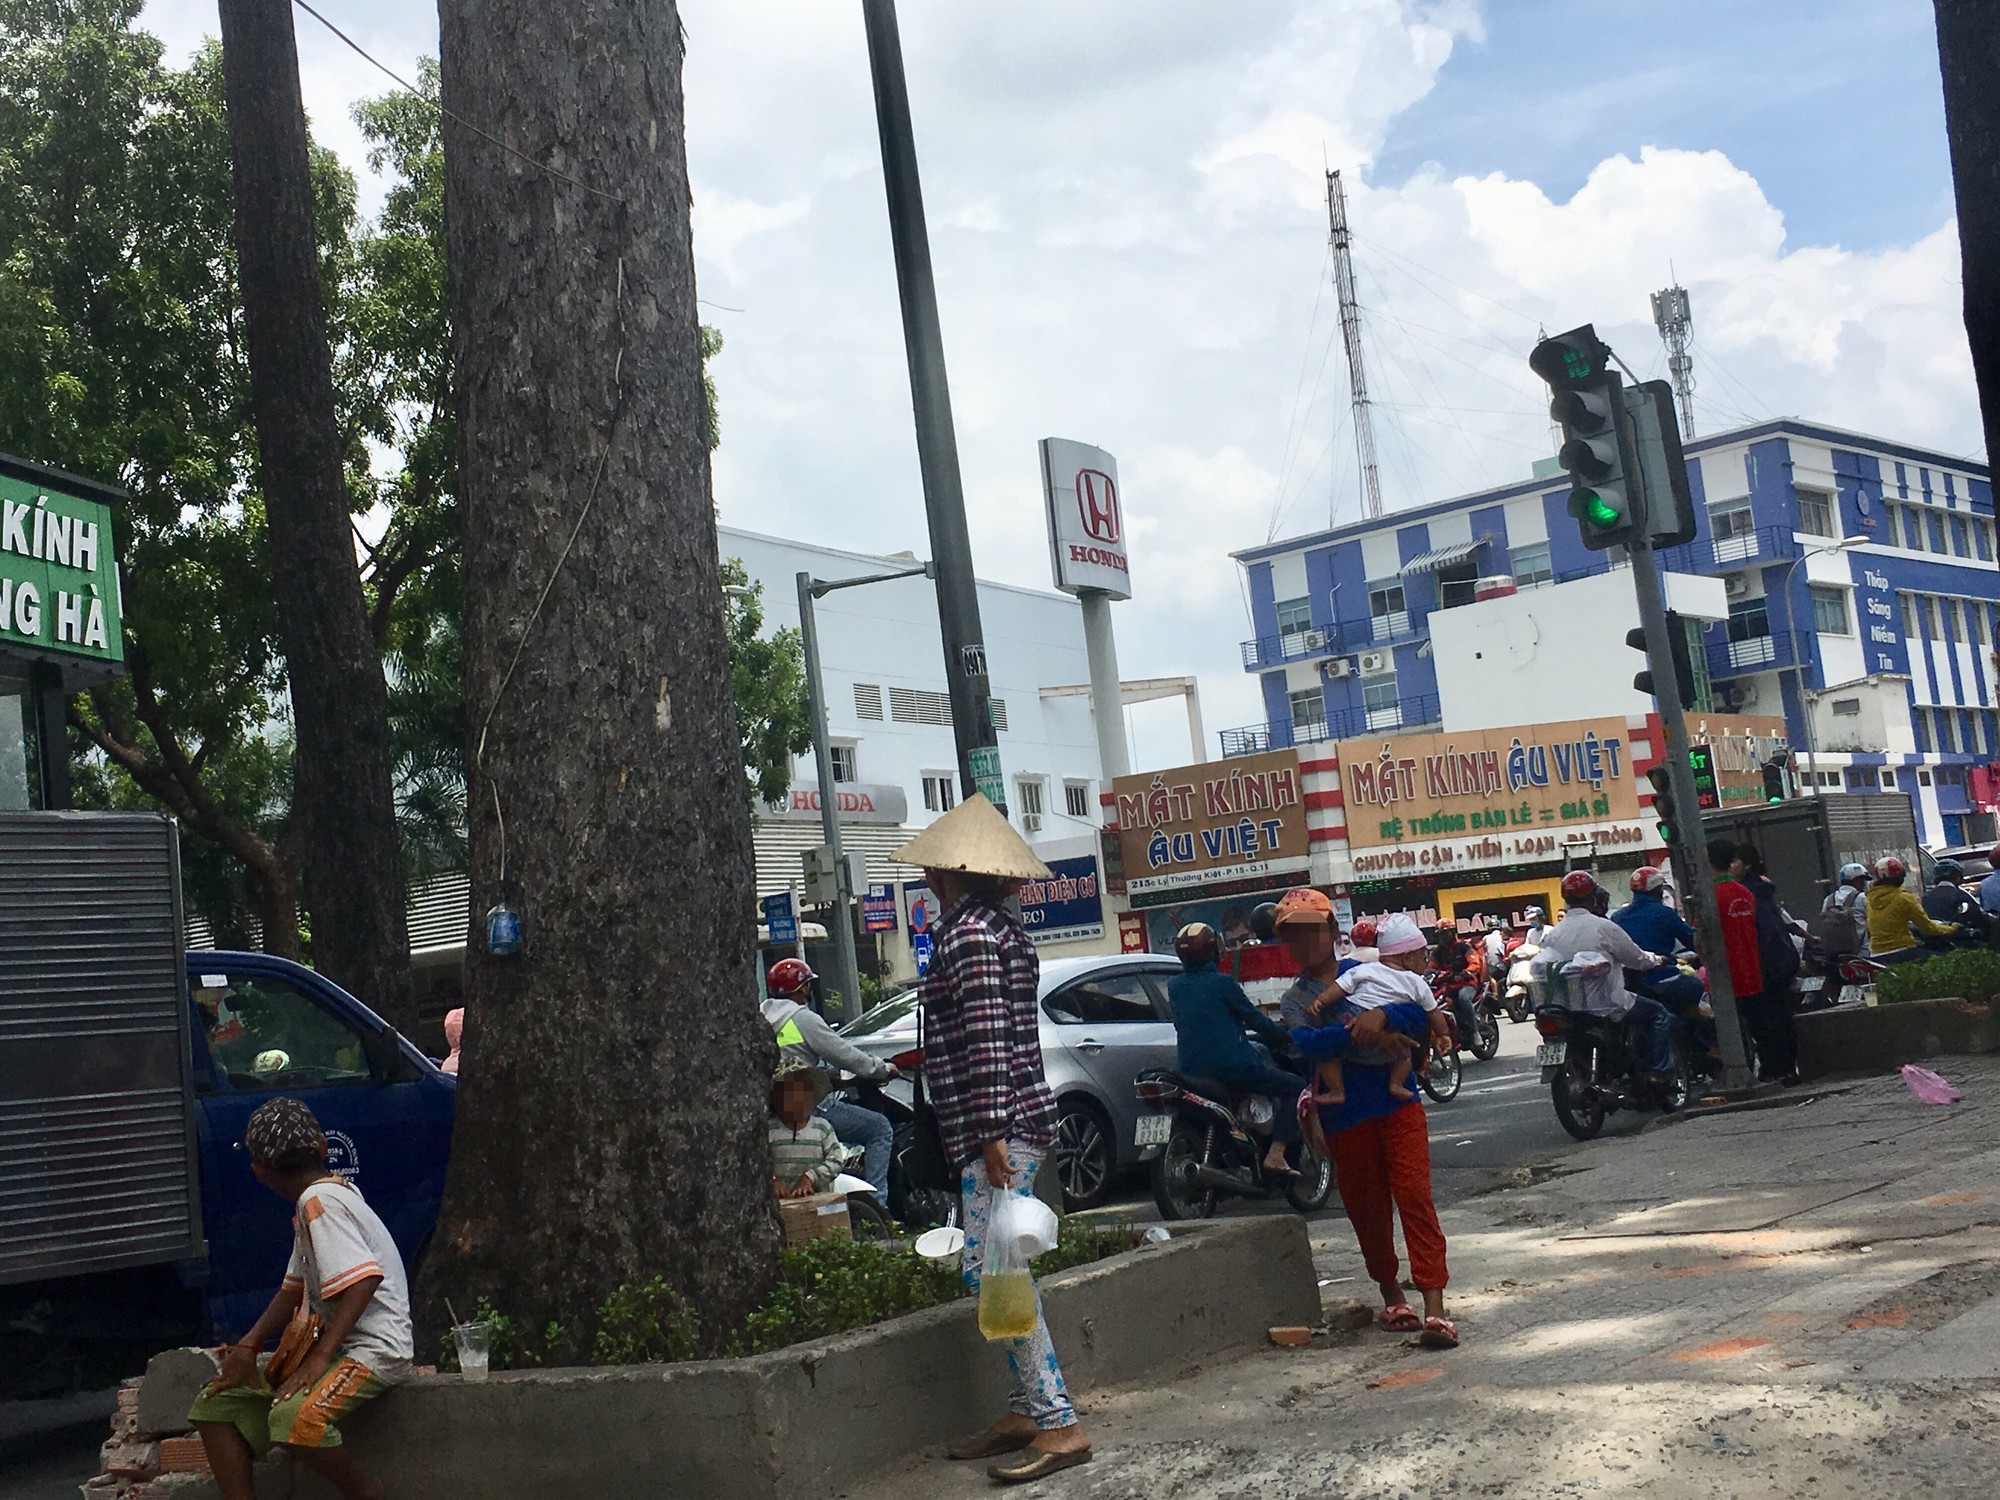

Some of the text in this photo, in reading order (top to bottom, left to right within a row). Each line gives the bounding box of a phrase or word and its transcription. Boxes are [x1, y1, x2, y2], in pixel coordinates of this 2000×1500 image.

[2, 495, 98, 572] KÍNH
[1069, 544, 1128, 574] HONDA
[58, 583, 109, 649] HÀ
[1878, 653, 1893, 670] Tin
[1349, 743, 1418, 808] MẮT
[1425, 743, 1502, 799] KÍNH
[1507, 737, 1550, 794] ÂU
[1552, 730, 1621, 791] VIỆT
[1118, 768, 1298, 831] MẮT KÍNH
[1147, 817, 1284, 869] ÂU VIỆT
[1046, 873, 1077, 905] ĐIỆN
